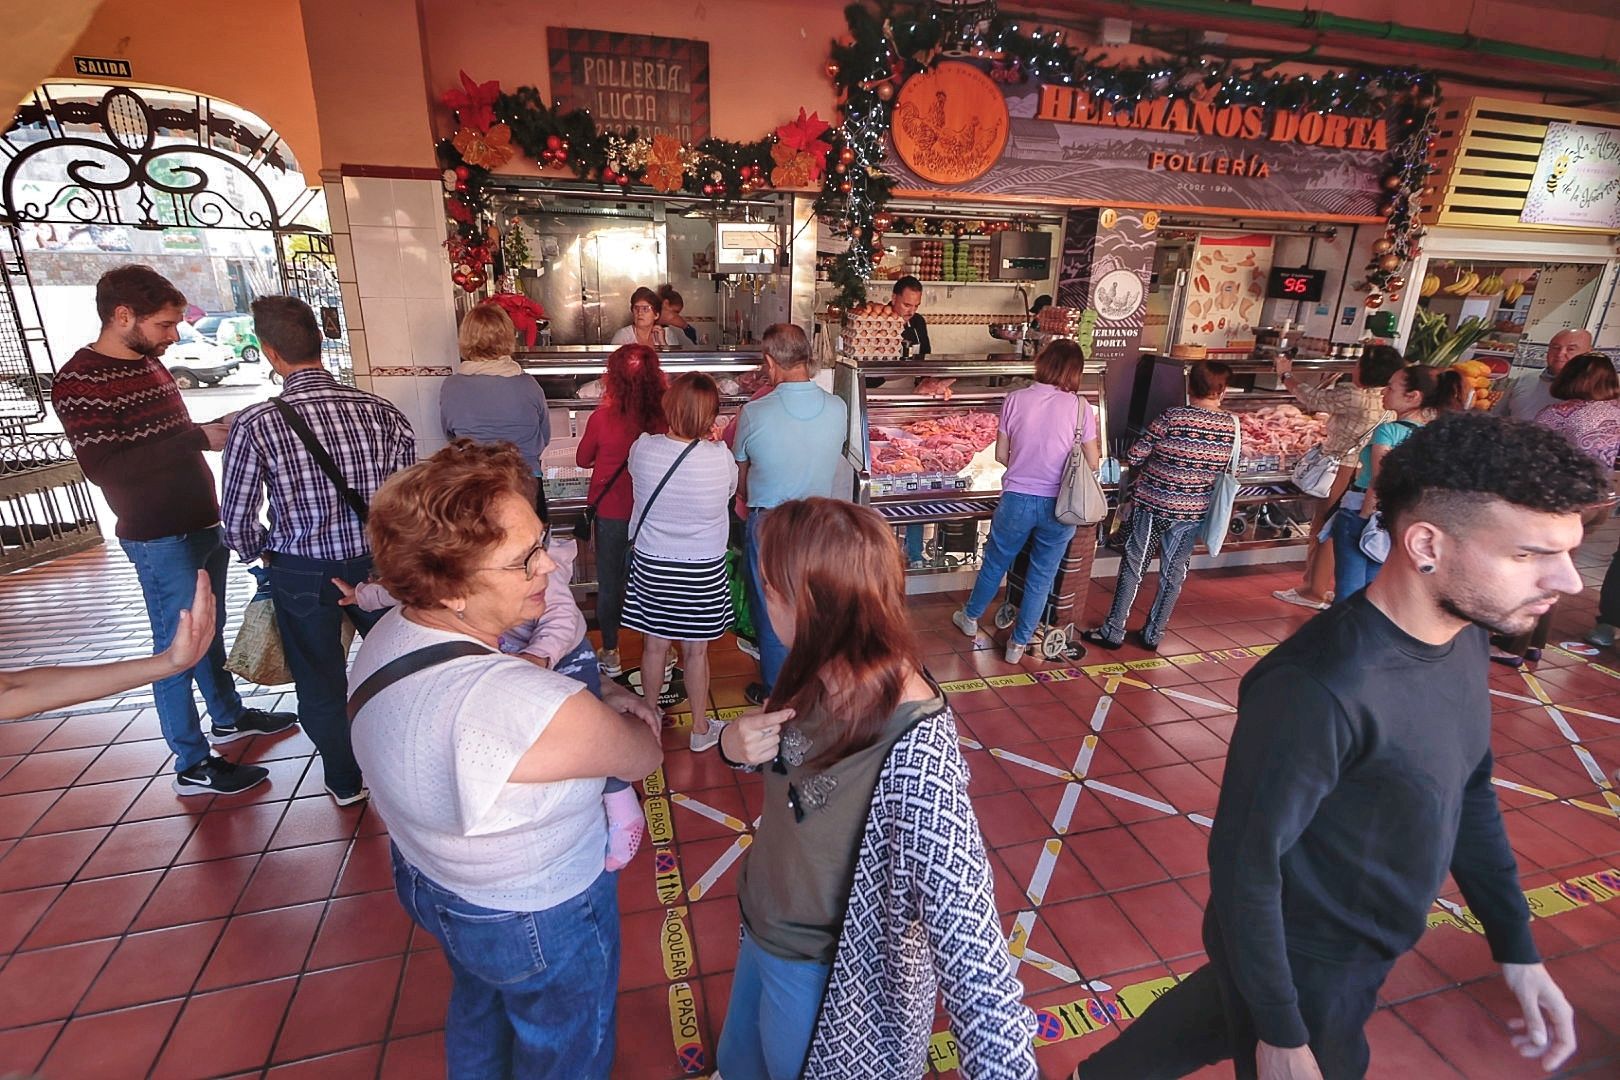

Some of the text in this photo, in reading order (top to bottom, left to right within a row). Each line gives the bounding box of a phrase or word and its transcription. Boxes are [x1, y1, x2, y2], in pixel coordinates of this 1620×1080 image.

[79, 60, 128, 76] SALIDA
[583, 57, 683, 92] POLLERÍA
[598, 90, 656, 122] LUCÍA
[1038, 84, 1388, 150] HERMANOS DORTA
[1151, 151, 1270, 178] POLLERÍA
[1104, 213, 1114, 224] 11
[1146, 215, 1156, 226] 12
[1284, 278, 1307, 293] 96
[1096, 339, 1127, 347] DORTA
[651, 812, 665, 836] PASO
[677, 1000, 697, 1039] PASO
